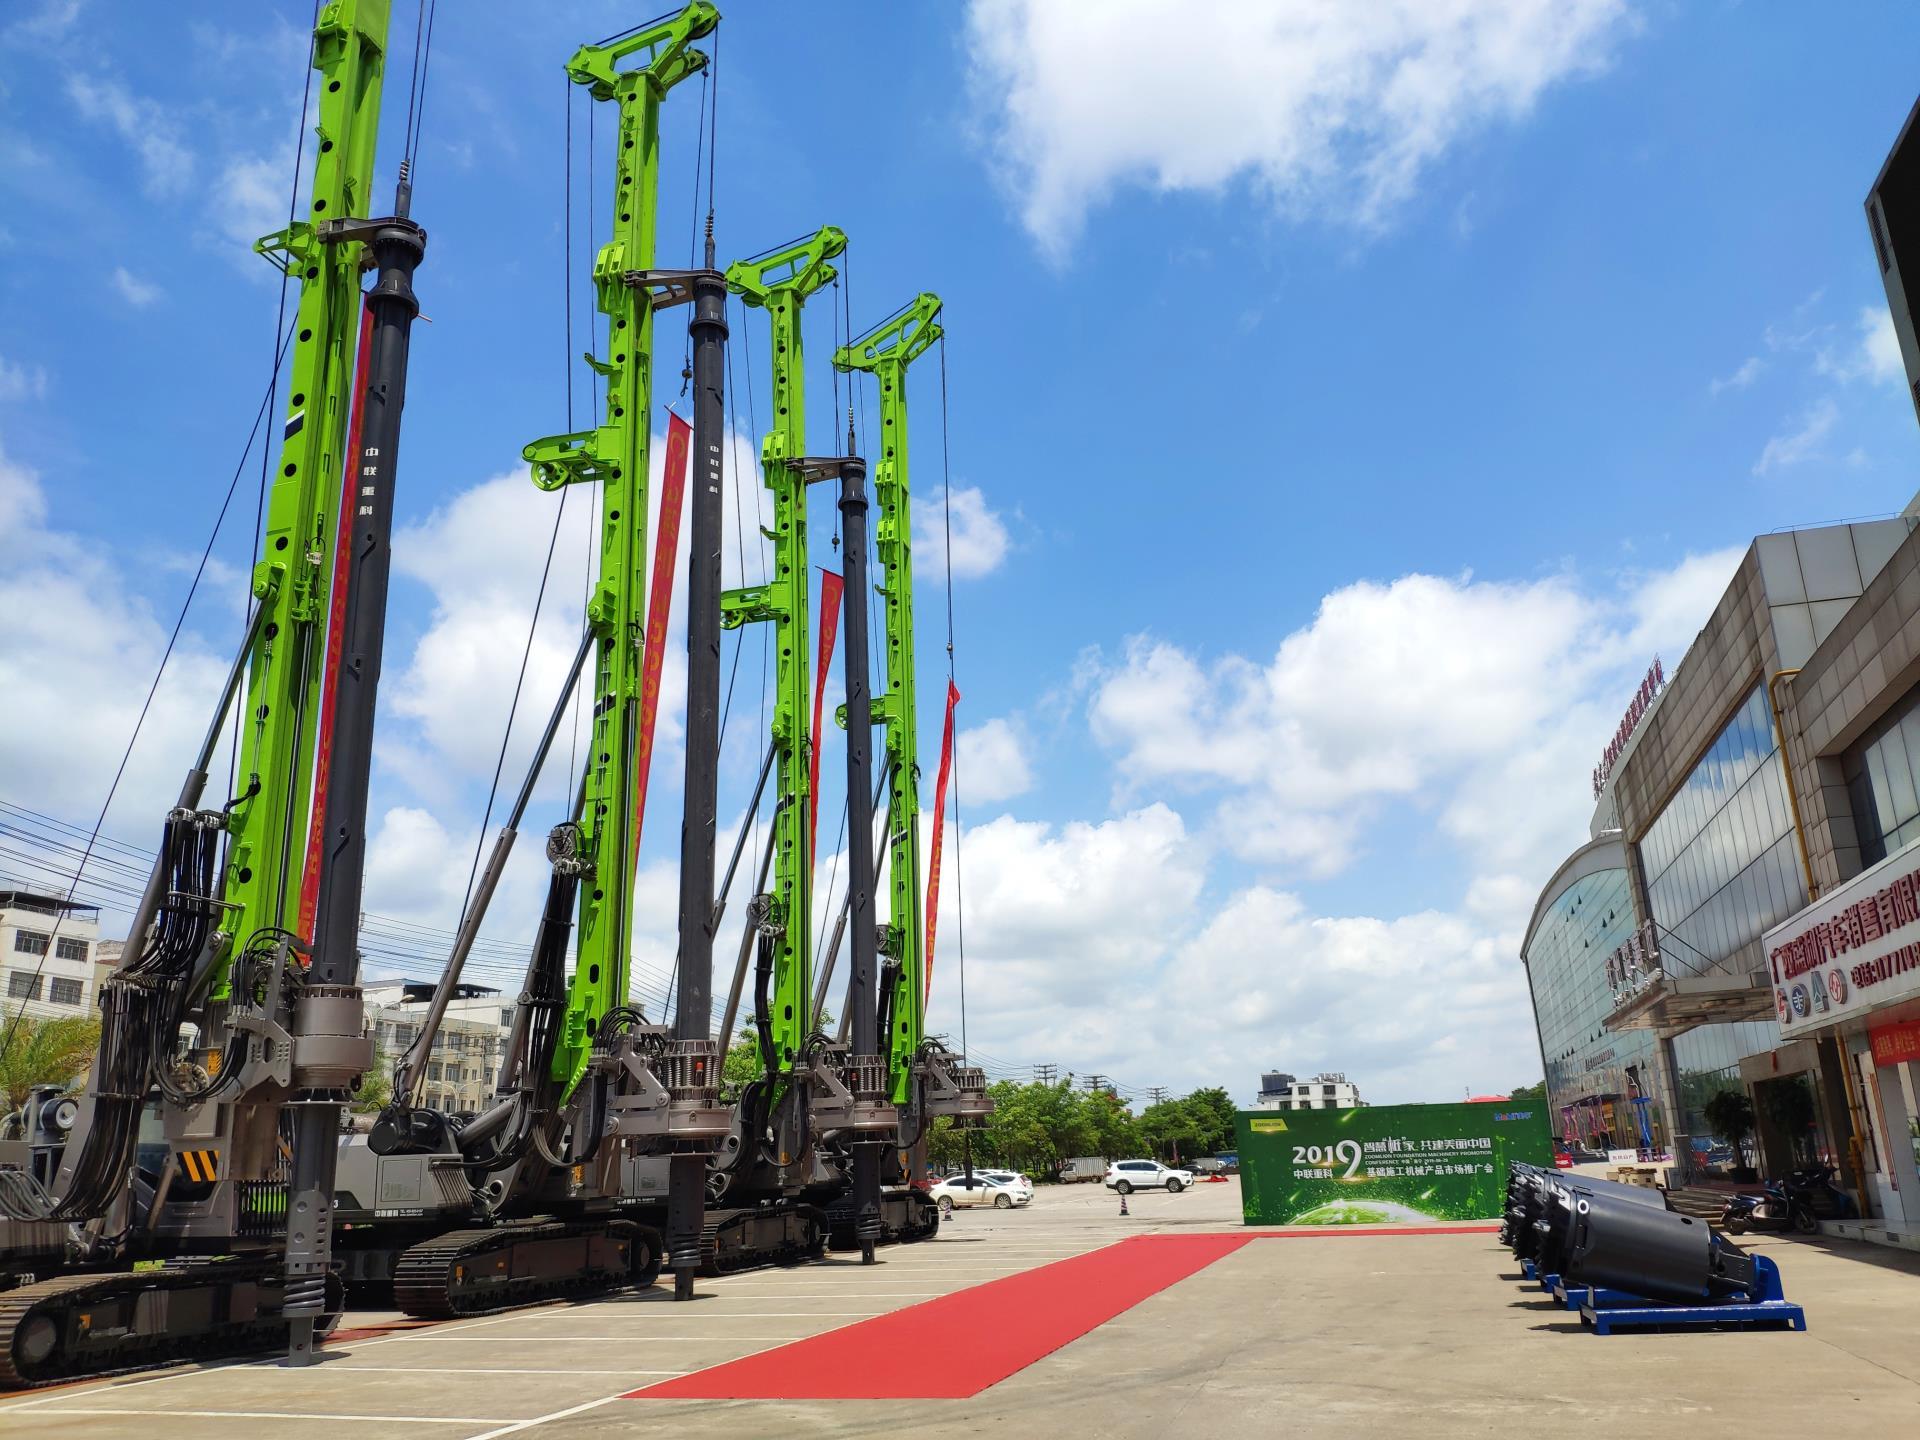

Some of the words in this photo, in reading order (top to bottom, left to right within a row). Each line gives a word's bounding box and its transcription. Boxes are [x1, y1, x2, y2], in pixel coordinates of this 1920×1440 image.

[359, 447, 379, 516] 中联重科
[1421, 1137, 1491, 1150] 共建美丽中国
[1292, 1139, 1362, 1179] 2019
[1293, 1168, 1334, 1180] 中联重科
[1366, 1163, 1494, 1178] 基础施工机械产品市场推广会
